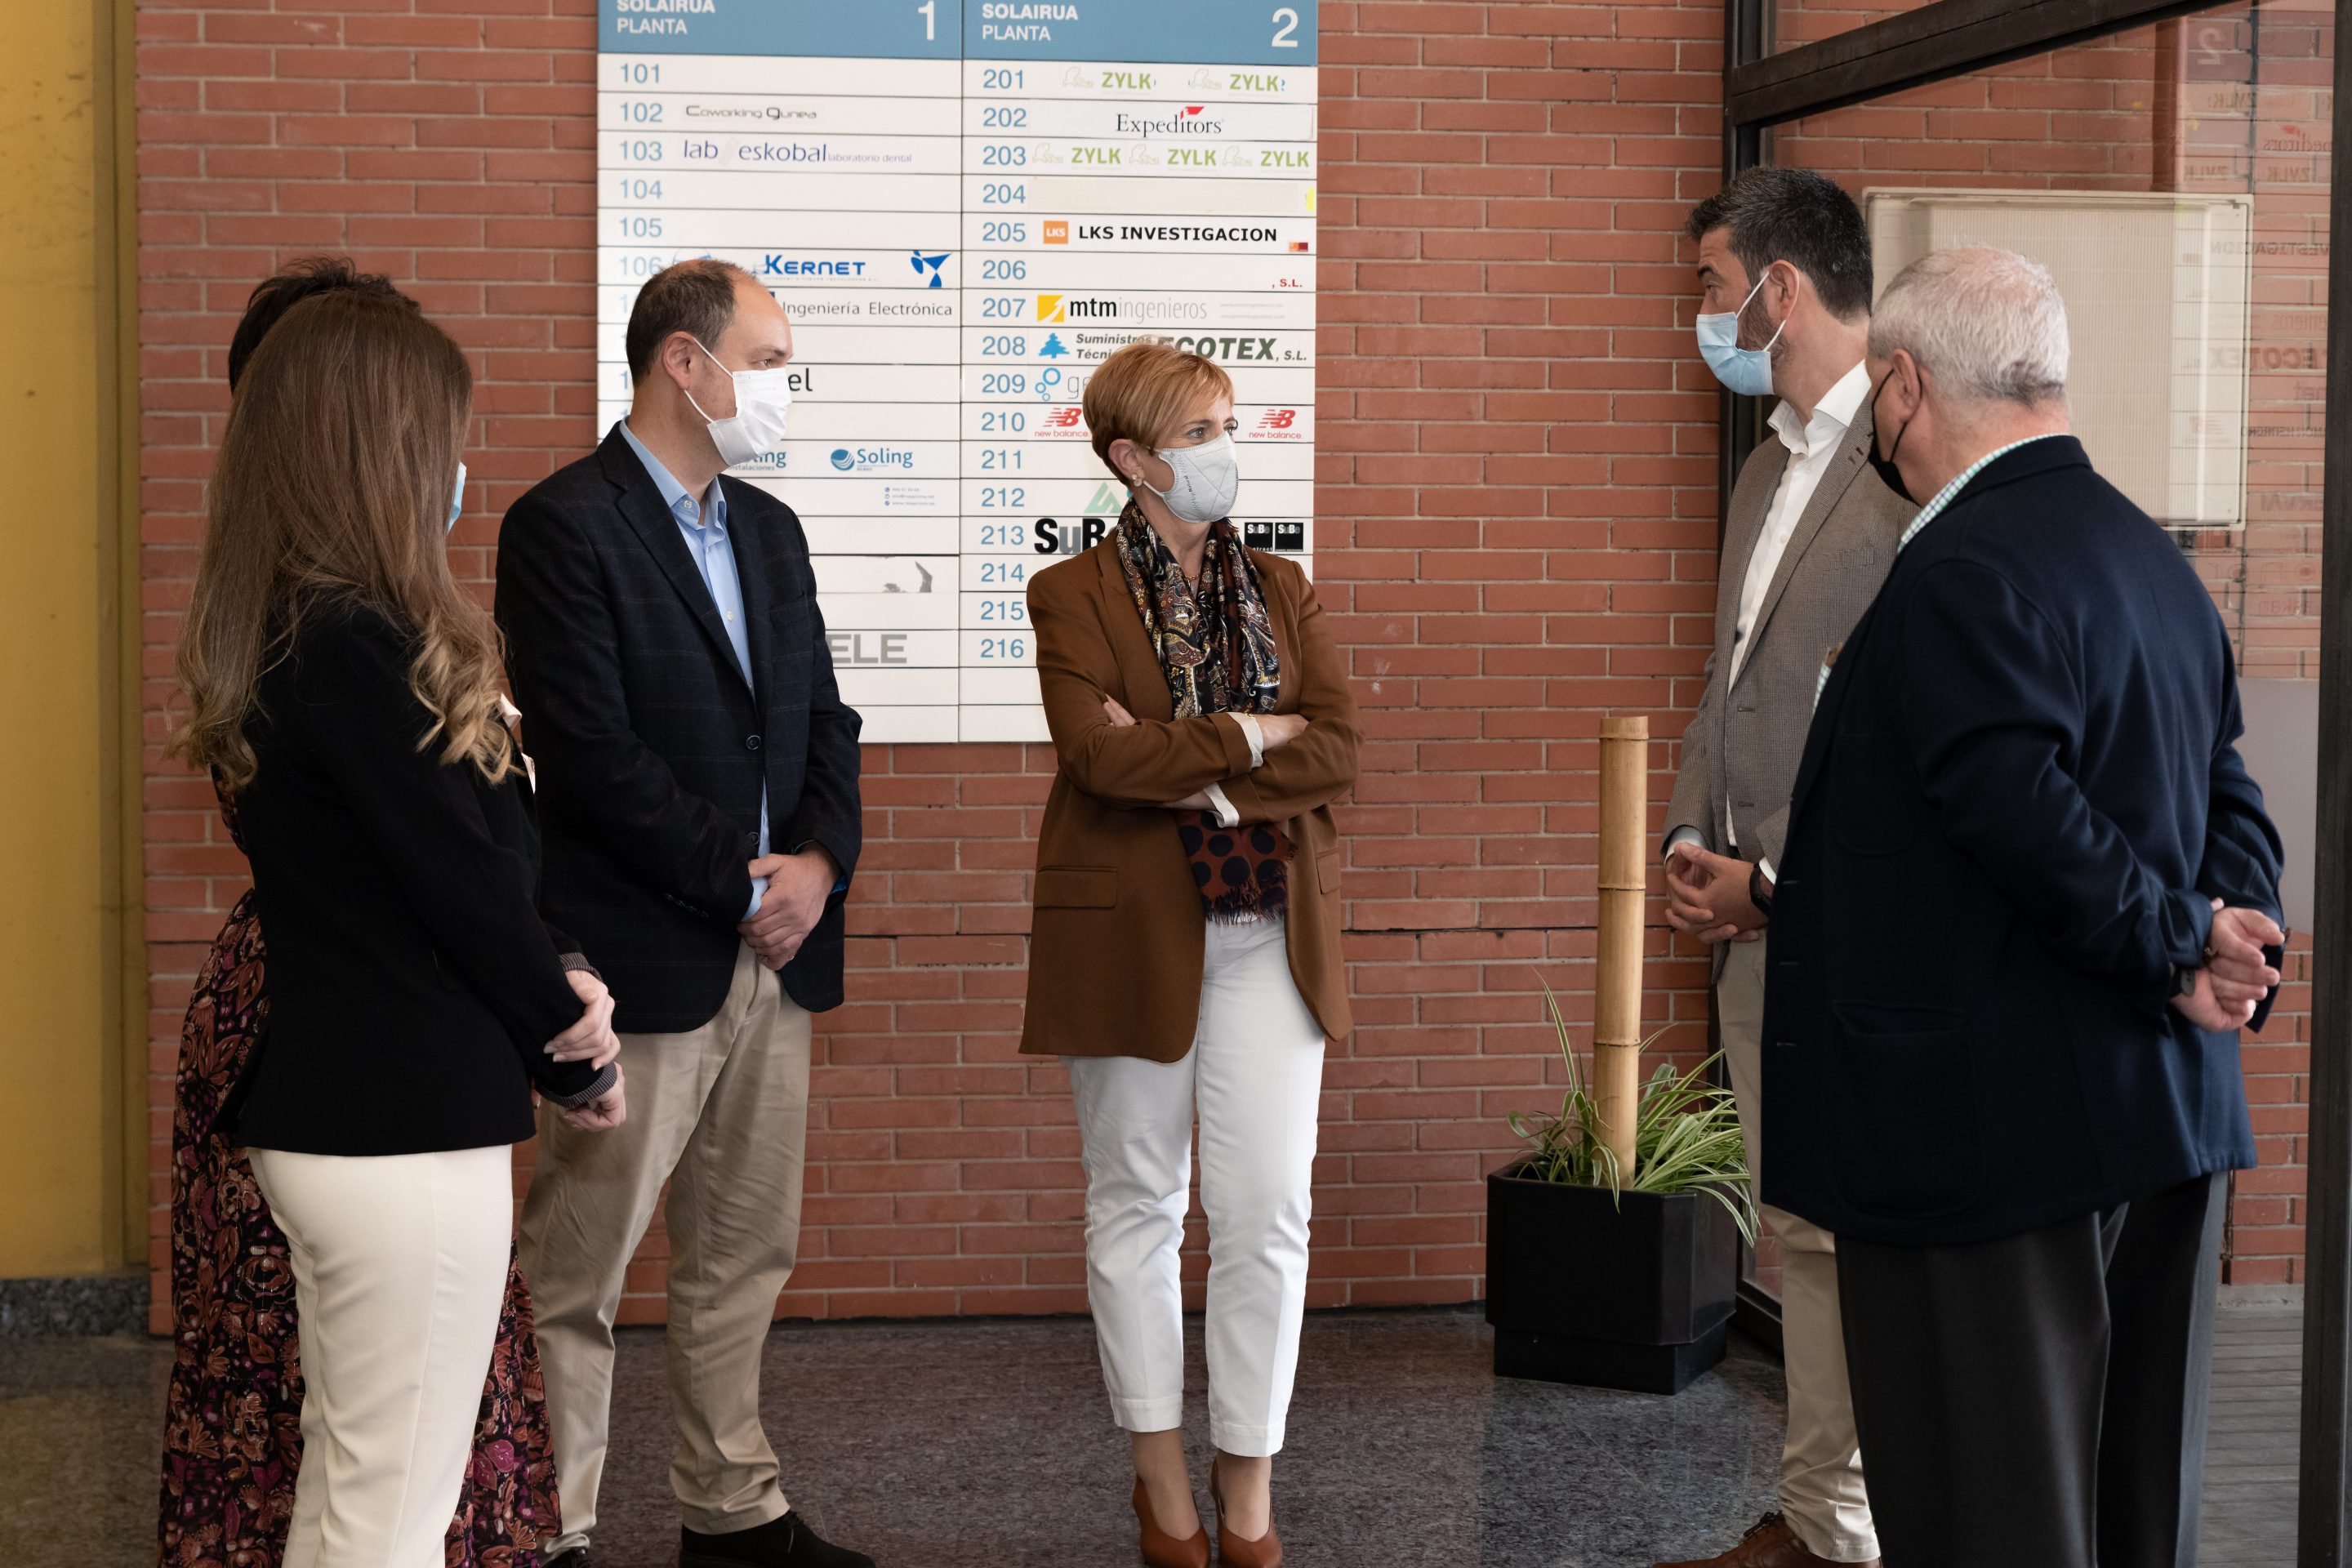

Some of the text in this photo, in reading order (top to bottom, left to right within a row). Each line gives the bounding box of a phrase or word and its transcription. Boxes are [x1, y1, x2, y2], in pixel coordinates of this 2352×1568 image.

[617, 0, 715, 13] SOLAIRUA
[982, 3, 1078, 20] SOLAIRUA
[617, 18, 687, 34] PLANTA
[918, 0, 934, 40] 1
[1272, 8, 1298, 47] 2
[982, 24, 1051, 41] PLANTA
[621, 64, 659, 83] 101
[983, 69, 1278, 91] 201 ZYLK ZYLK
[621, 102, 662, 122] 102
[983, 108, 1223, 139] 202 Expeditors
[620, 140, 662, 161] 103
[684, 140, 718, 158] lab
[739, 142, 826, 162] eskobal
[982, 146, 1308, 167] 203 ZYLK ZYLK ZYLK
[621, 179, 662, 199] 104
[983, 184, 1026, 203] 204
[620, 217, 662, 238] 105
[982, 222, 1276, 242] 205 LKS LKS INVESTIGACION
[982, 260, 1026, 279] 206
[870, 302, 951, 315] Electrónica
[982, 298, 1026, 318] 207
[982, 336, 1025, 356] 208
[1284, 350, 1306, 360] S.L.
[982, 374, 1025, 394] 209
[982, 412, 1025, 432] 210
[1053, 430, 1089, 438] balance
[1268, 431, 1303, 439] balance
[858, 448, 913, 470] Soling
[982, 450, 1021, 469] 211
[982, 488, 1024, 507] 212
[981, 525, 1024, 546] 213
[981, 563, 1024, 582] 214
[980, 600, 1024, 620] 215
[980, 639, 1023, 658] 216
